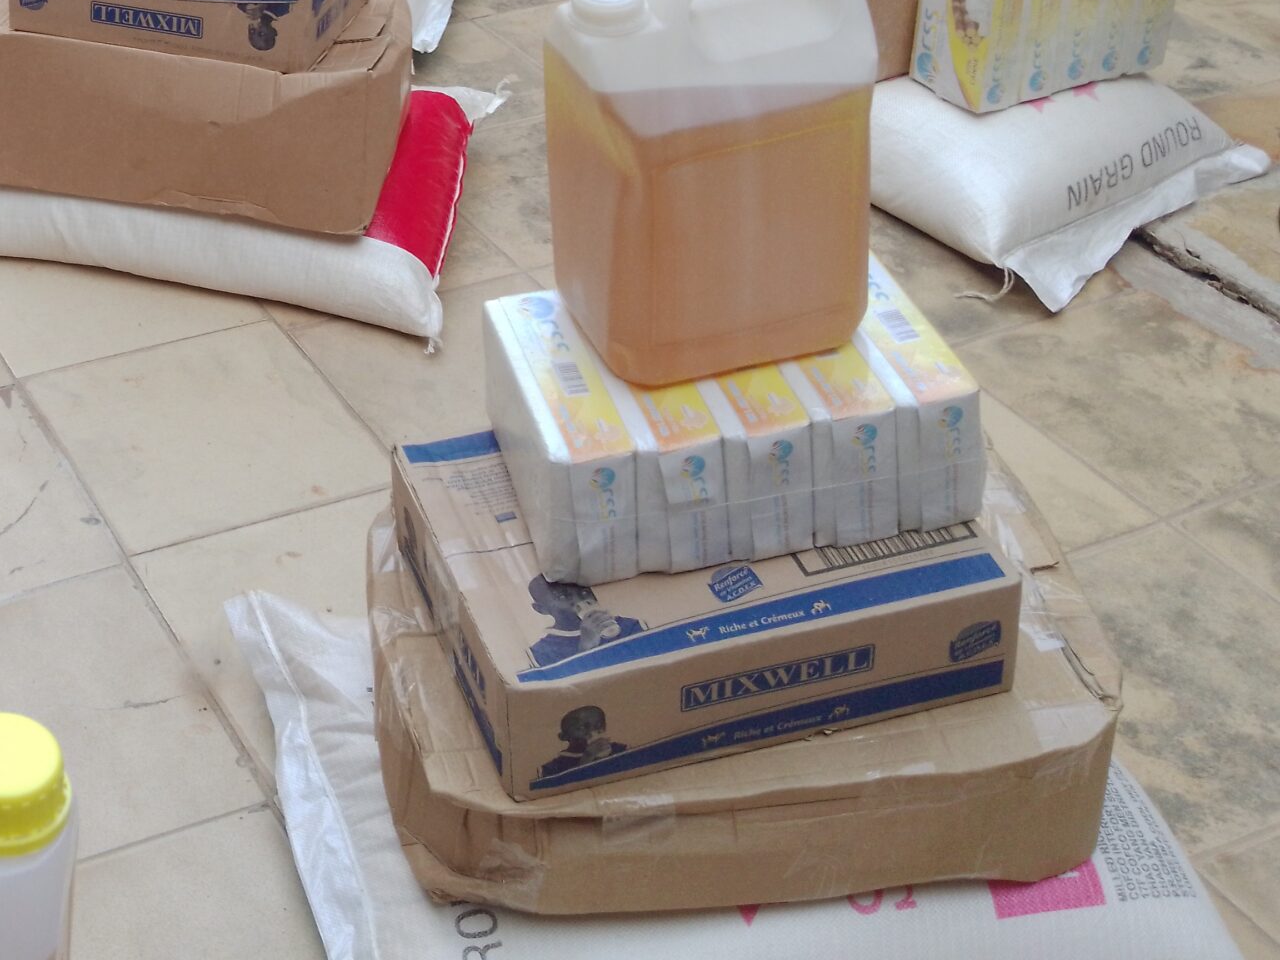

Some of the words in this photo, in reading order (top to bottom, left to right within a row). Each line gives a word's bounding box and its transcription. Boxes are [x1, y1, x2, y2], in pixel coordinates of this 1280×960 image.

[95, 5, 199, 36] MIXWELL
[1141, 116, 1202, 168] ROUND
[1067, 154, 1134, 211] GRAIN
[714, 565, 749, 592] Renforcé
[719, 621, 748, 635] Riche
[748, 619, 759, 628] et
[760, 609, 806, 625] Crémeux
[689, 651, 868, 706] MIXWELL
[734, 727, 761, 740] Riche
[777, 715, 823, 730] Crémeux
[1118, 834, 1141, 875] COFCO
[1135, 830, 1154, 860] YANG
[1117, 857, 1139, 900] COFCO
[1141, 863, 1160, 898] CHAO
[1151, 863, 1171, 898] CHAO
